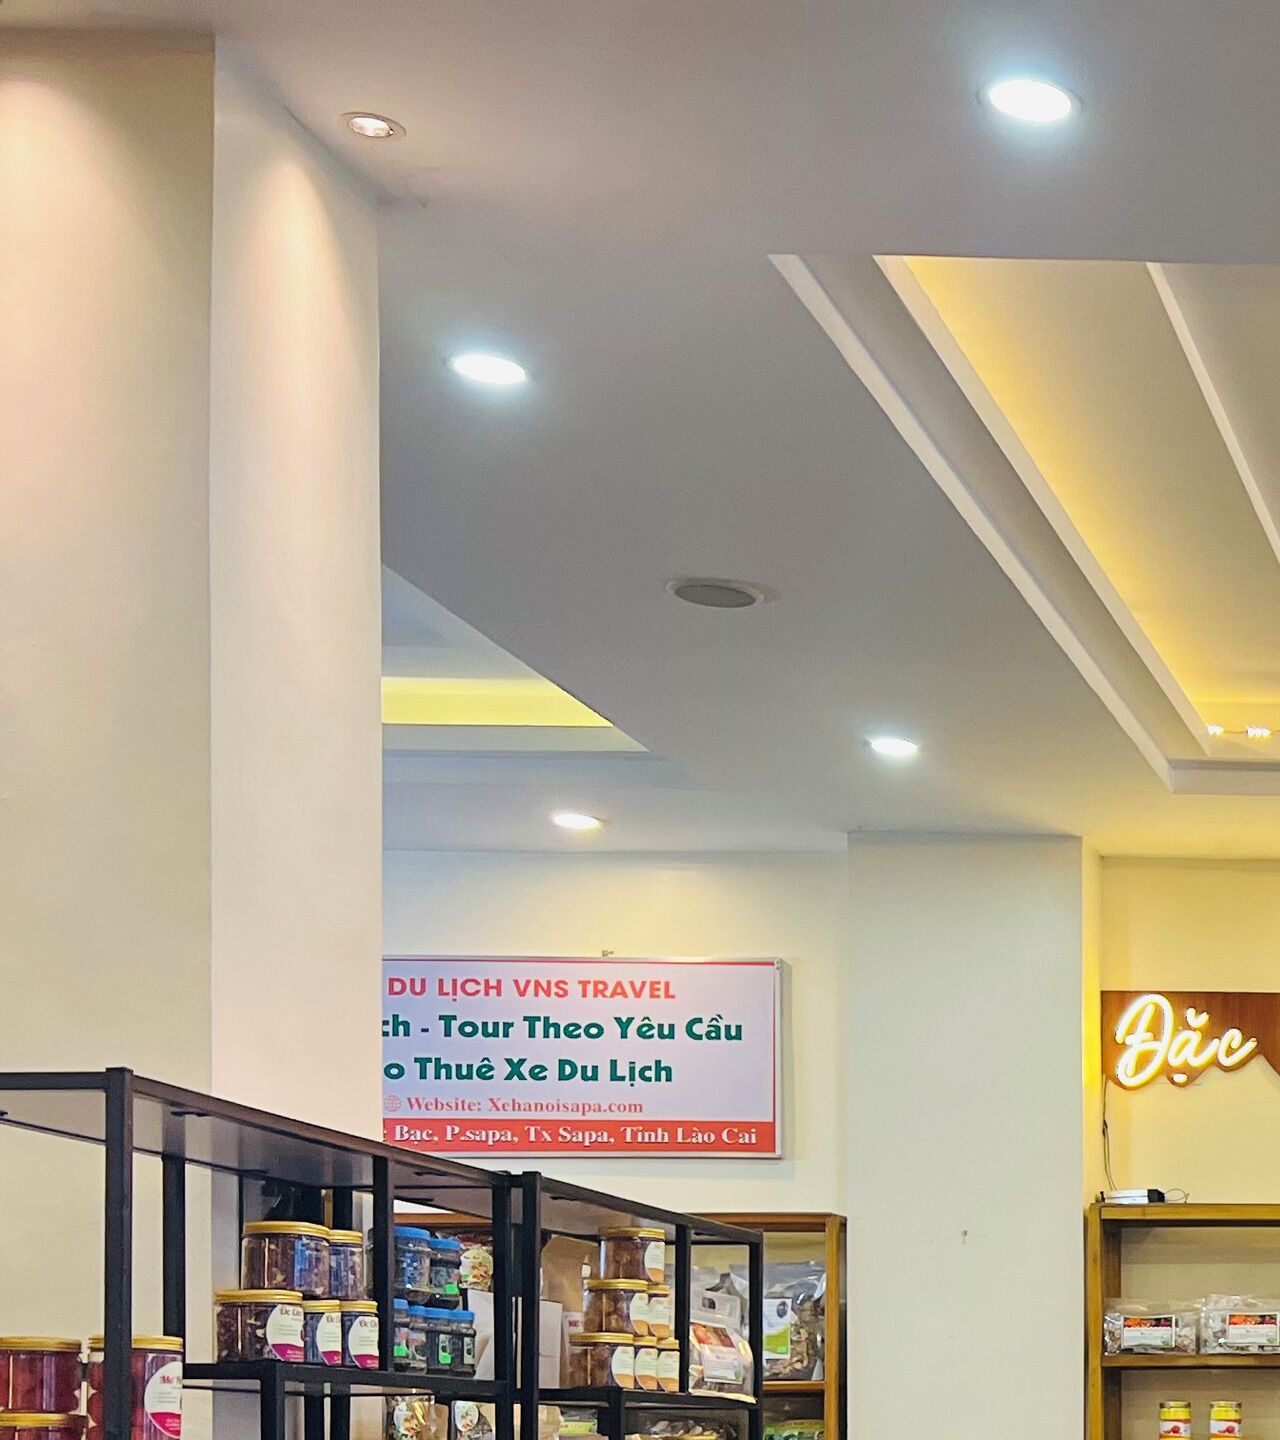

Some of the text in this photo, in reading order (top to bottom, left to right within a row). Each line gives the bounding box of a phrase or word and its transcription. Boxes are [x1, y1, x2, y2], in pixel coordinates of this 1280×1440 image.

[388, 977, 676, 1002] DU LỊCH VNS TRAVEL
[438, 1015, 514, 1039] Tour
[523, 1016, 605, 1040] Theo
[614, 1016, 675, 1040] Yêu
[685, 1014, 742, 1041] Cầu
[1113, 992, 1258, 1090] Đặc
[414, 1057, 495, 1081] Thuê
[503, 1058, 548, 1082] Xe
[558, 1059, 599, 1082] Du
[609, 1059, 673, 1087] Lịch
[408, 1097, 644, 1116] Website: Xehanoisapa.com
[394, 1125, 439, 1147] Bạc,
[446, 1125, 518, 1146] P.sapa,
[524, 1126, 552, 1143] Tx
[558, 1126, 615, 1146] Sapa,
[676, 1125, 716, 1144] Lào
[721, 1127, 757, 1145] Cai
